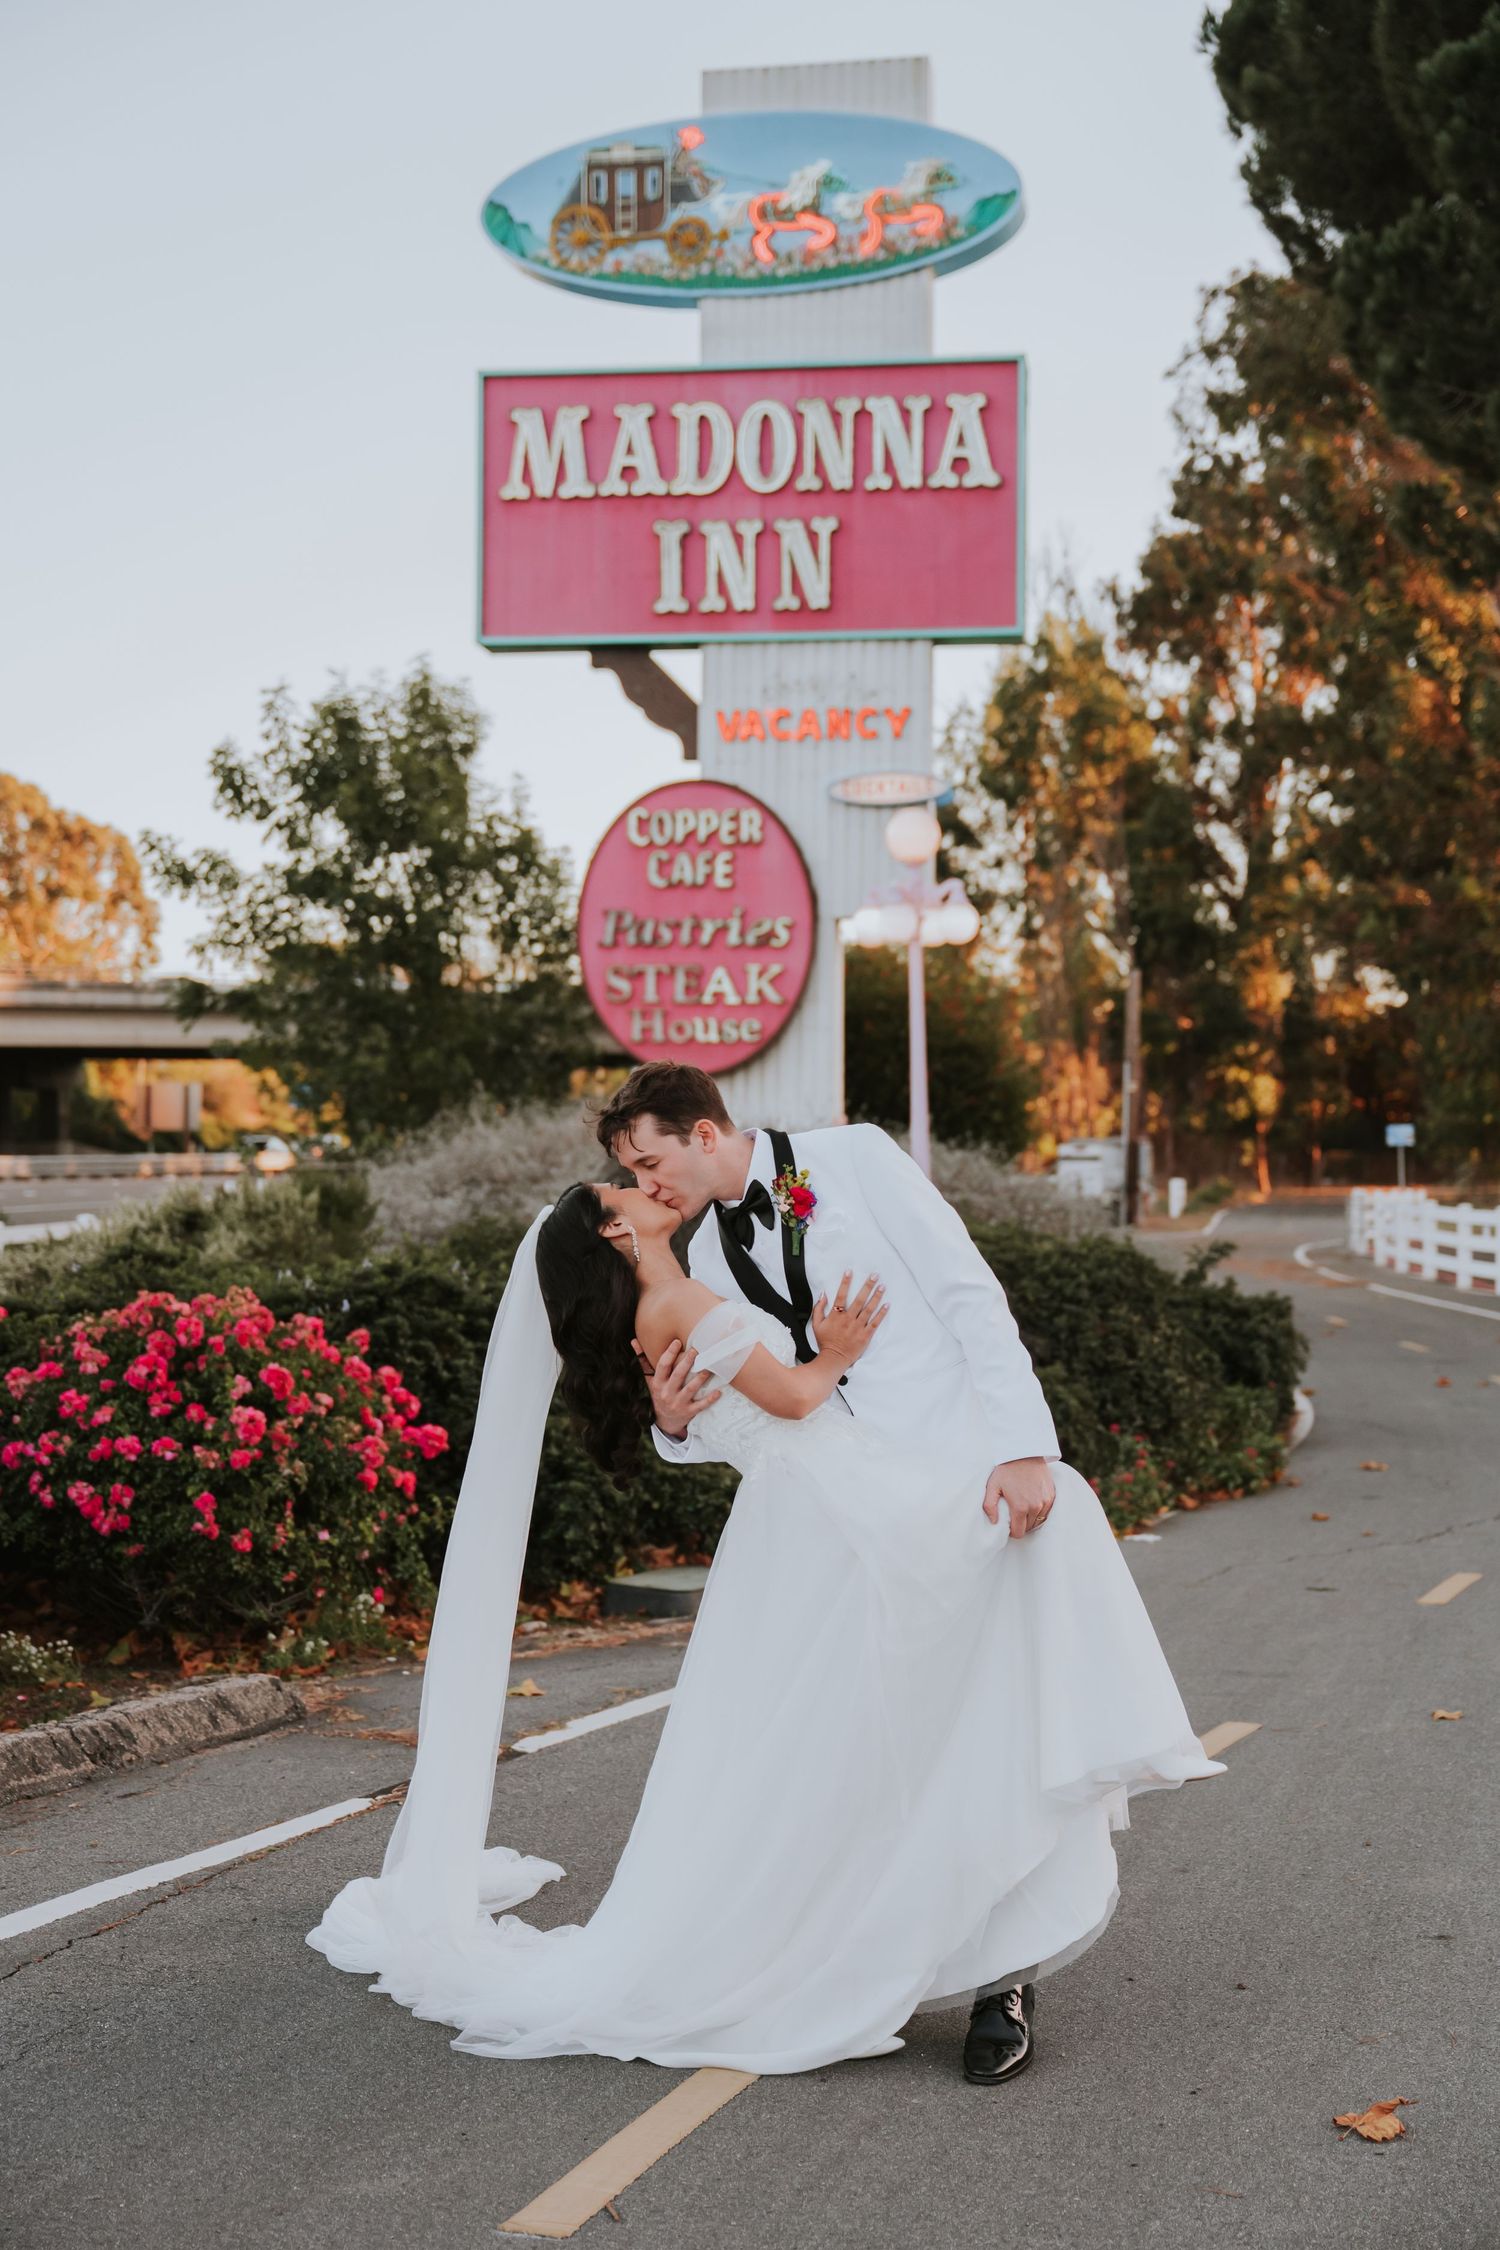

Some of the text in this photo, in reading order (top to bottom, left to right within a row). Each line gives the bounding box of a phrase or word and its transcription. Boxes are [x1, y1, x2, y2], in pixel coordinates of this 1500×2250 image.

[498, 392, 1002, 500] MADONNA
[652, 516, 840, 614] INN
[715, 707, 912, 742] VACANCY
[626, 806, 764, 848] COPPER
[647, 849, 735, 889] CAFE
[598, 906, 796, 948] Pastries
[605, 962, 786, 1006] STEAK
[630, 1005, 764, 1045] House
